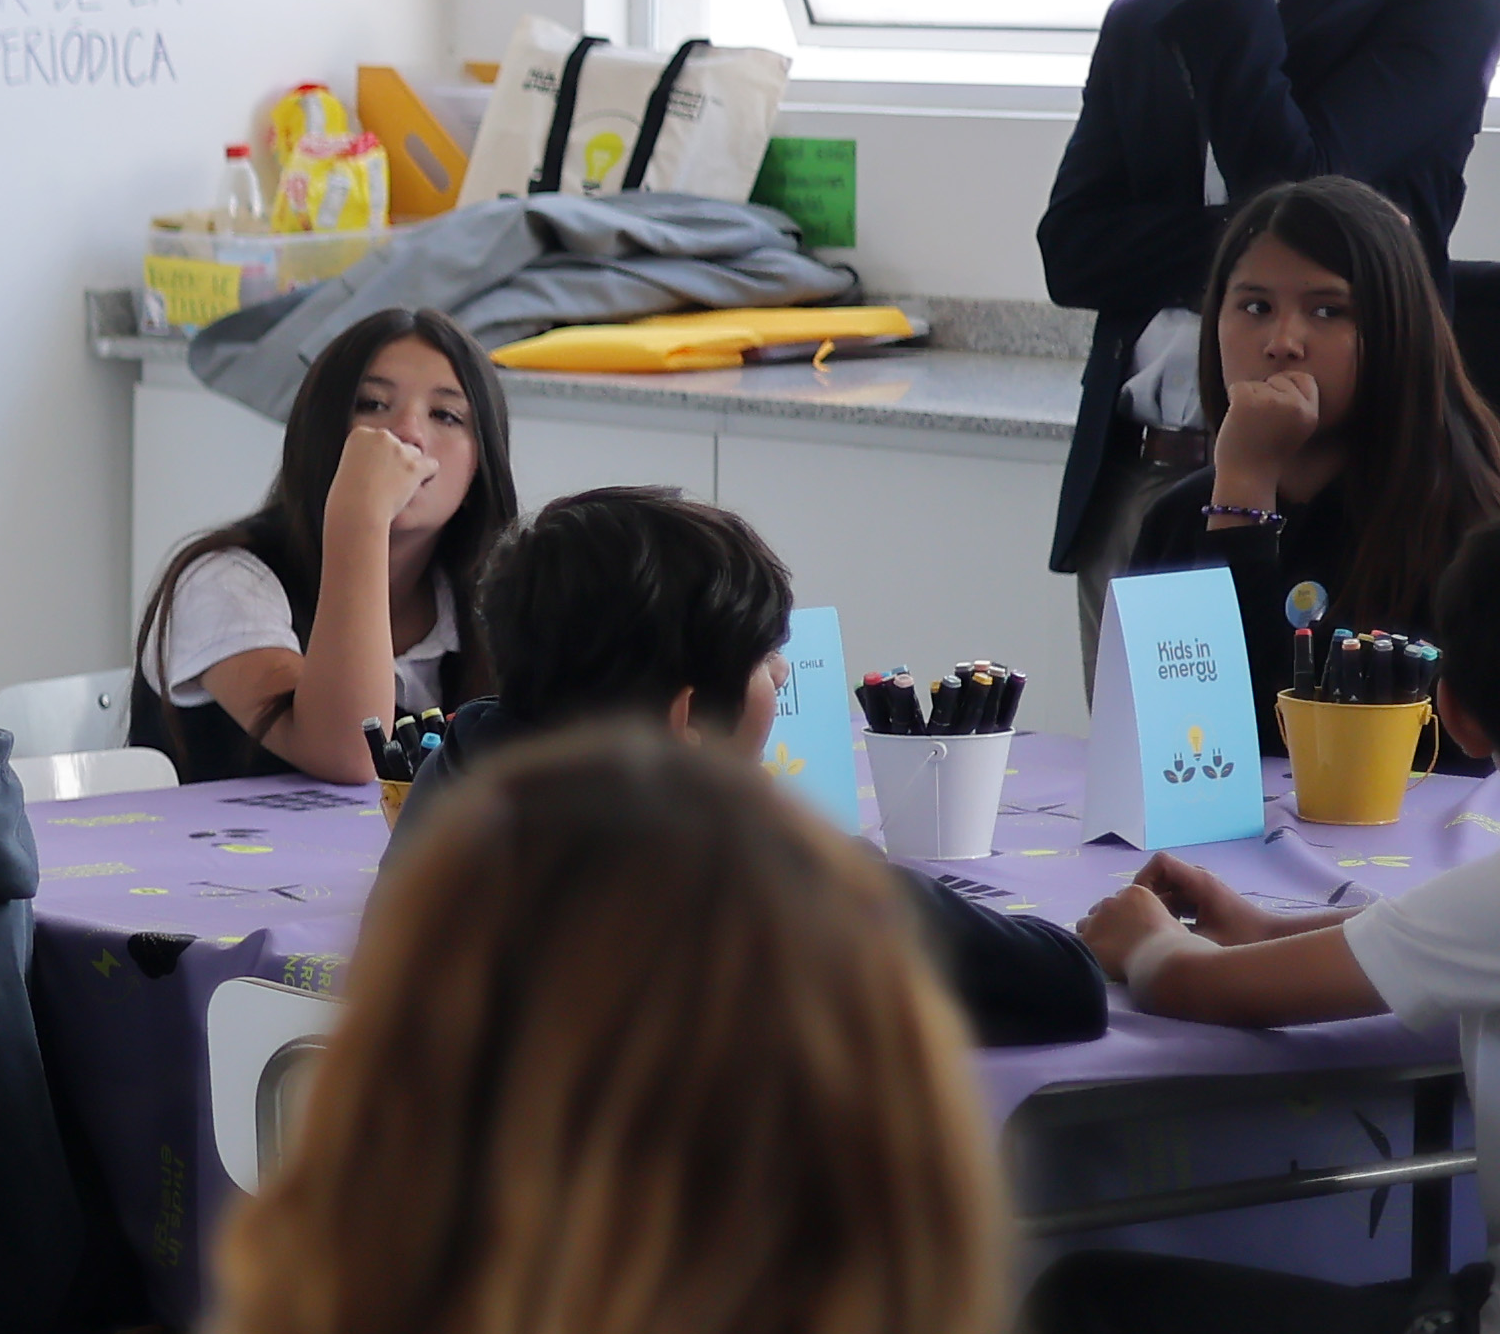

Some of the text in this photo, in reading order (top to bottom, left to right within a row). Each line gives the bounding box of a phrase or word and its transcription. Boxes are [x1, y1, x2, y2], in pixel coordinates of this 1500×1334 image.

[1156, 637, 1211, 662] Kids in
[799, 658, 825, 670] CHILE
[1157, 659, 1218, 683] energy
